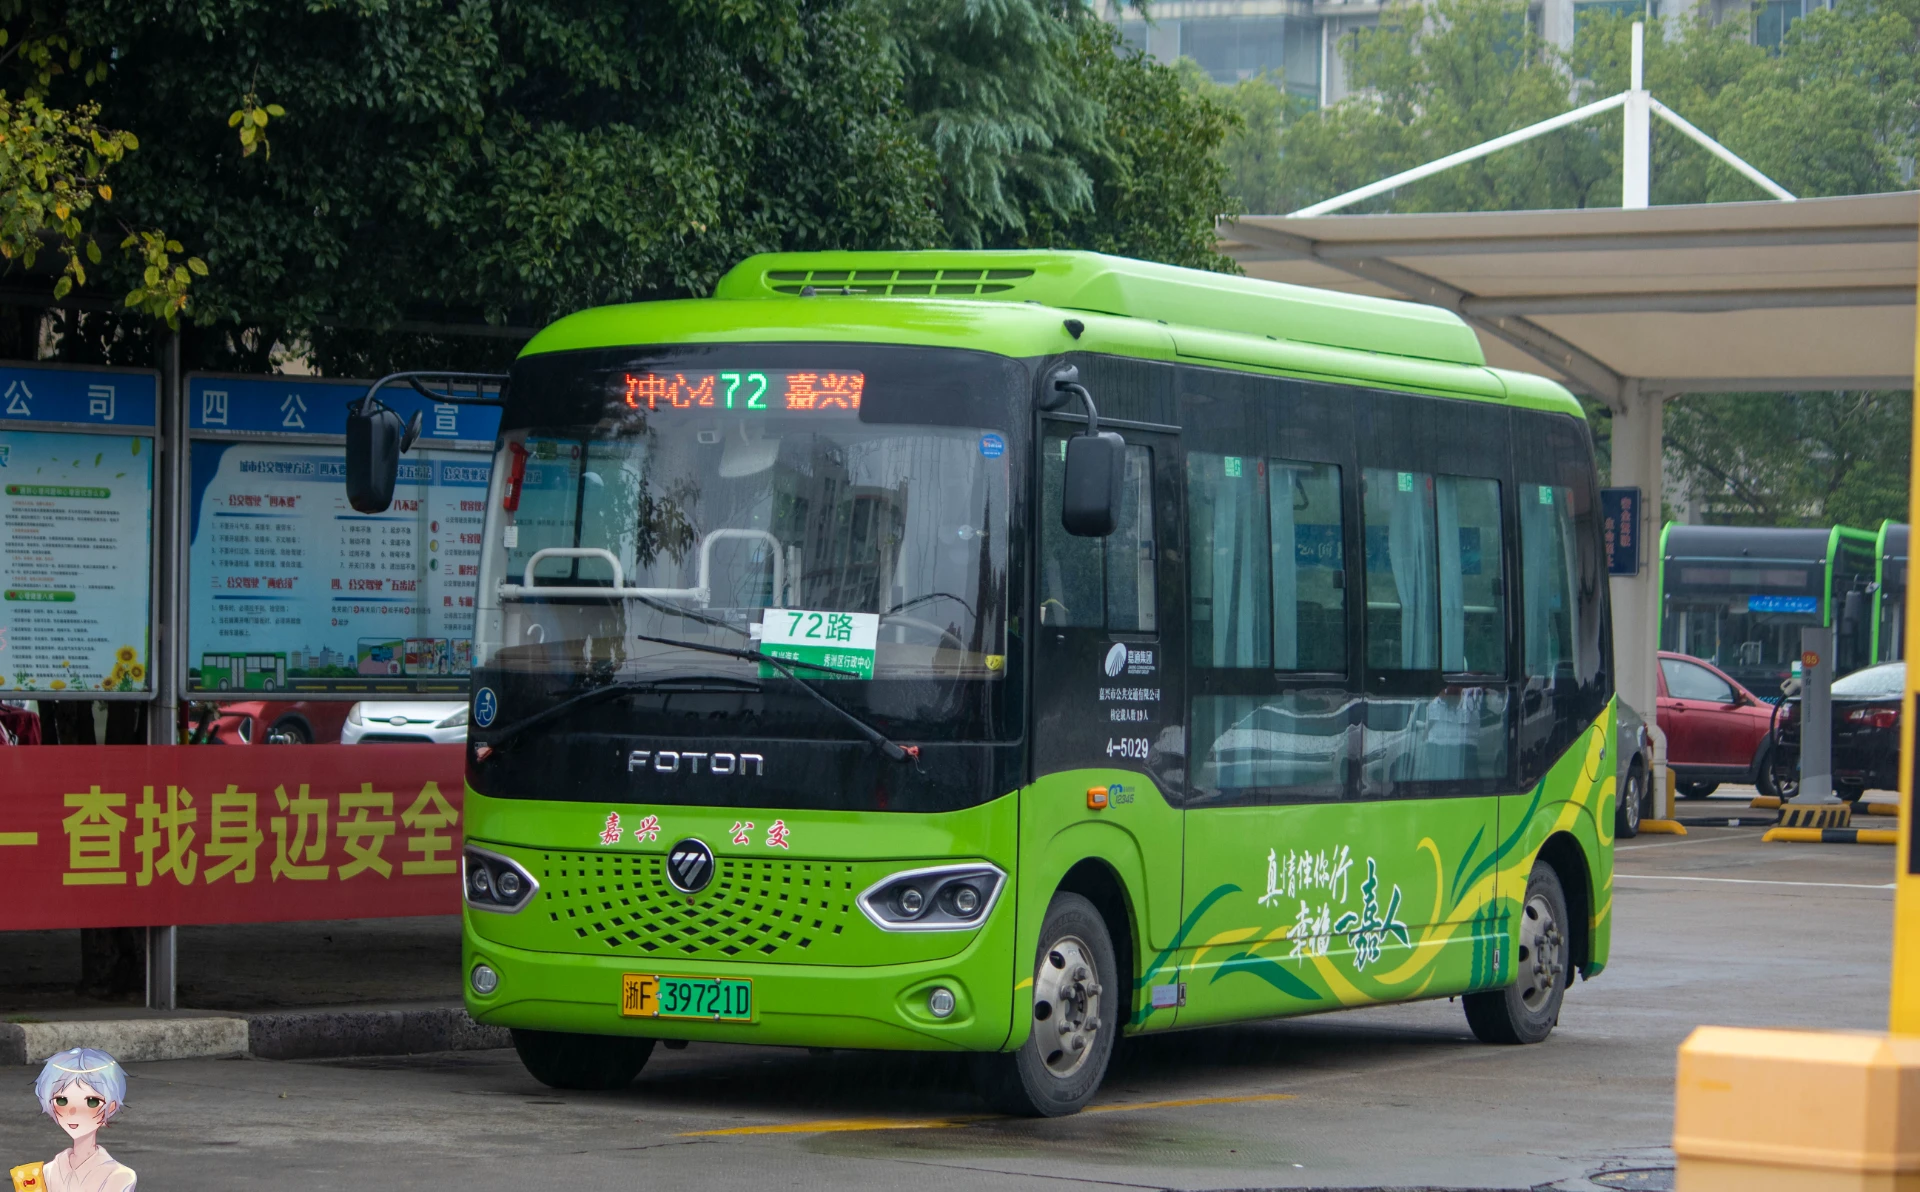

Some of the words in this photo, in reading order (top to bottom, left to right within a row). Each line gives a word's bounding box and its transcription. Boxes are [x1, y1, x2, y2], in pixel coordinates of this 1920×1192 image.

[721, 373, 767, 409] 72
[787, 611, 854, 642] 72路
[823, 653, 872, 670] 秀洲区行政中心
[1098, 687, 1161, 702] 嘉兴市公共交通有限公司
[1106, 738, 1149, 759] 4-5029
[627, 750, 764, 776] FOTON
[599, 811, 661, 846] 嘉兴
[729, 820, 790, 849] 公交
